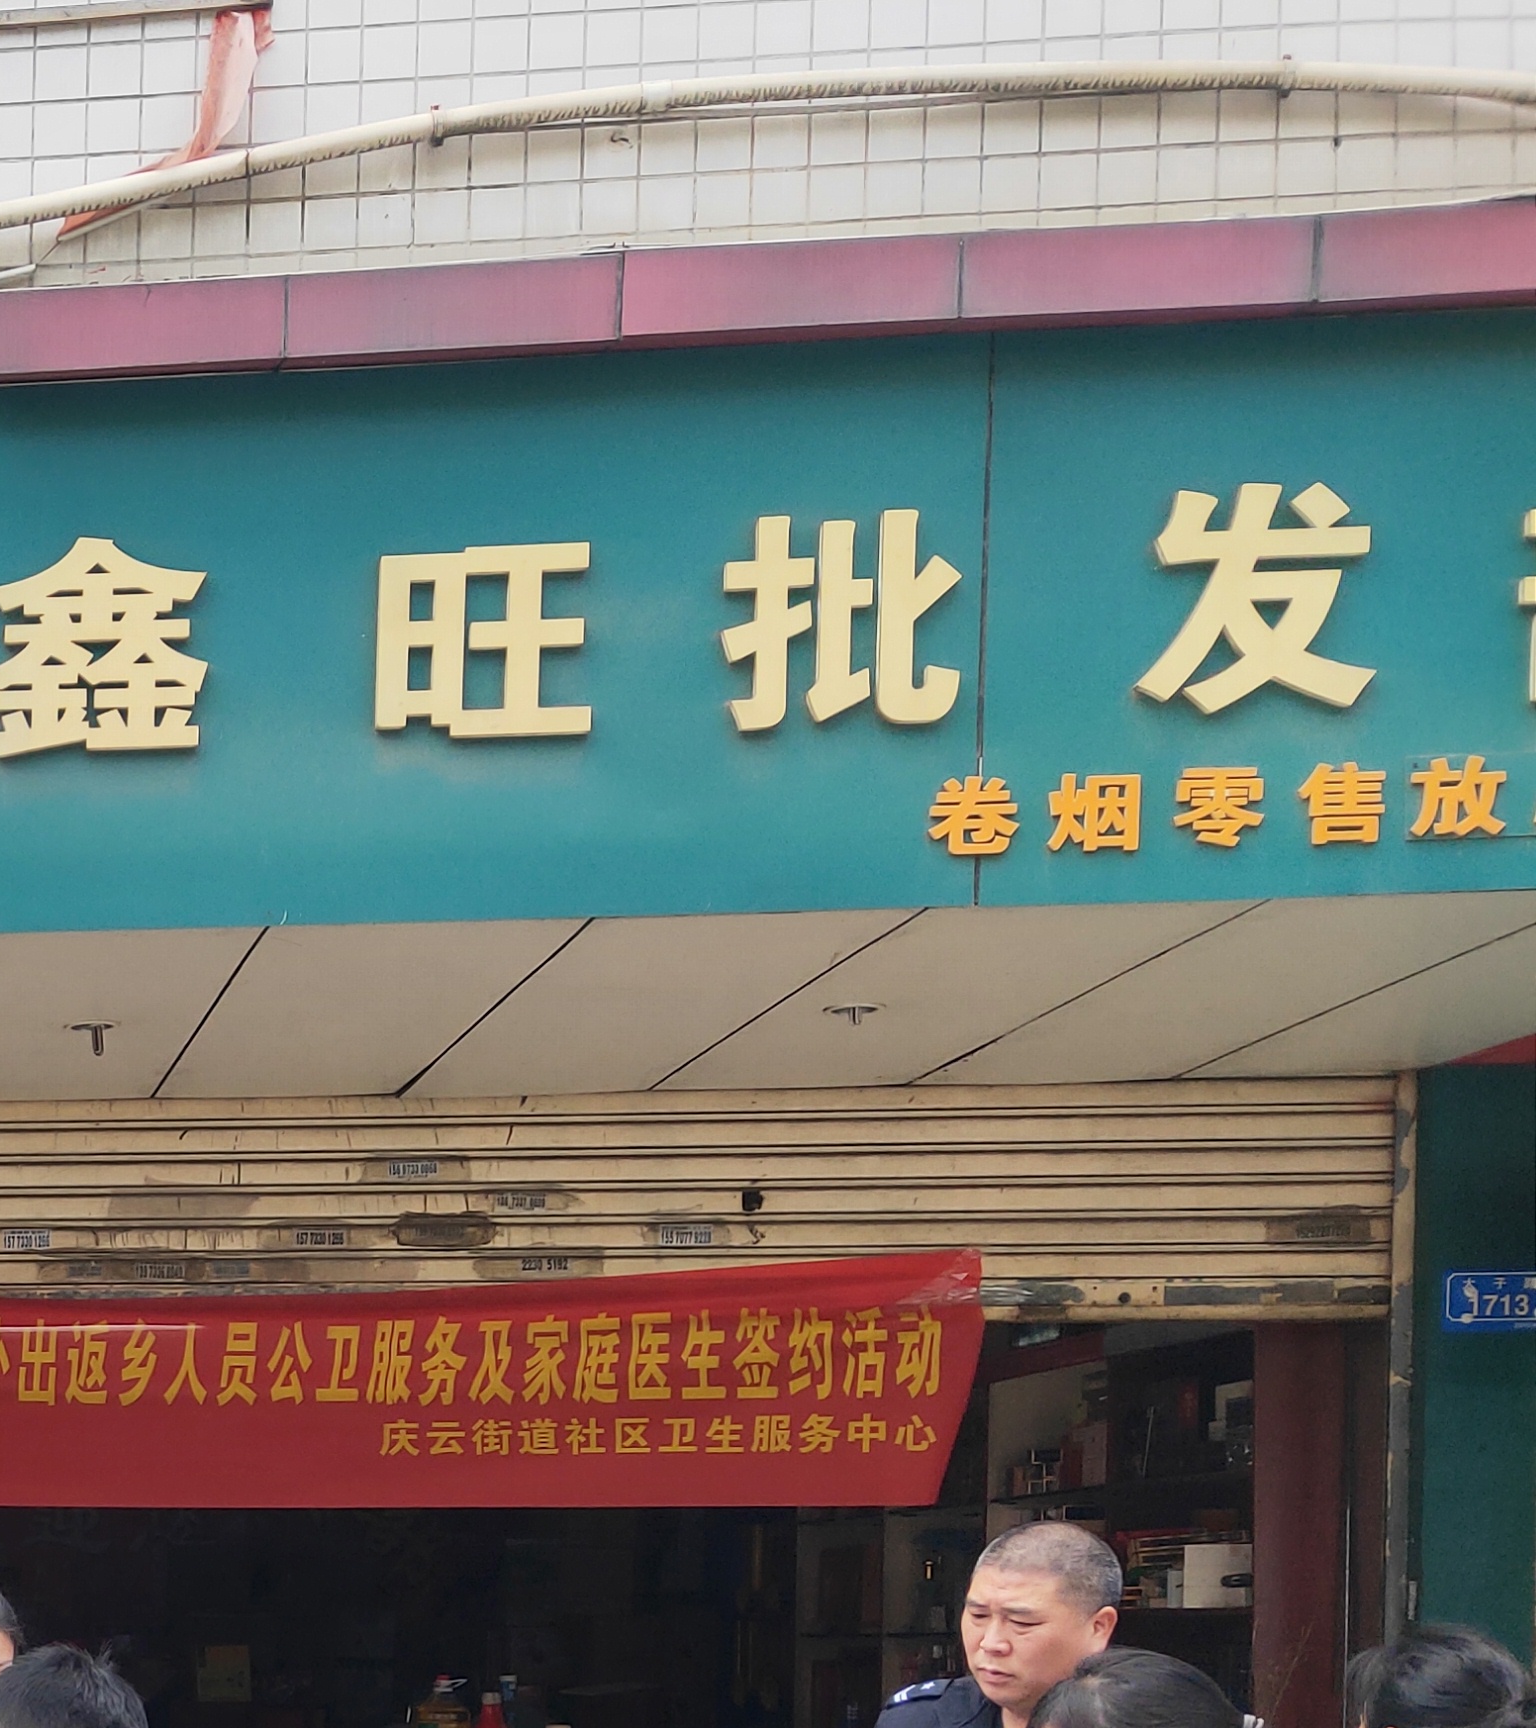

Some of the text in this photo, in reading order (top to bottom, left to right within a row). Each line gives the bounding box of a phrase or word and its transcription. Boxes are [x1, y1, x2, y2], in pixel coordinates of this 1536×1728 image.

[928, 752, 1508, 857] 卷烟零售放
[379, 1413, 938, 1457] 庆云街道社区卫生服务中心
